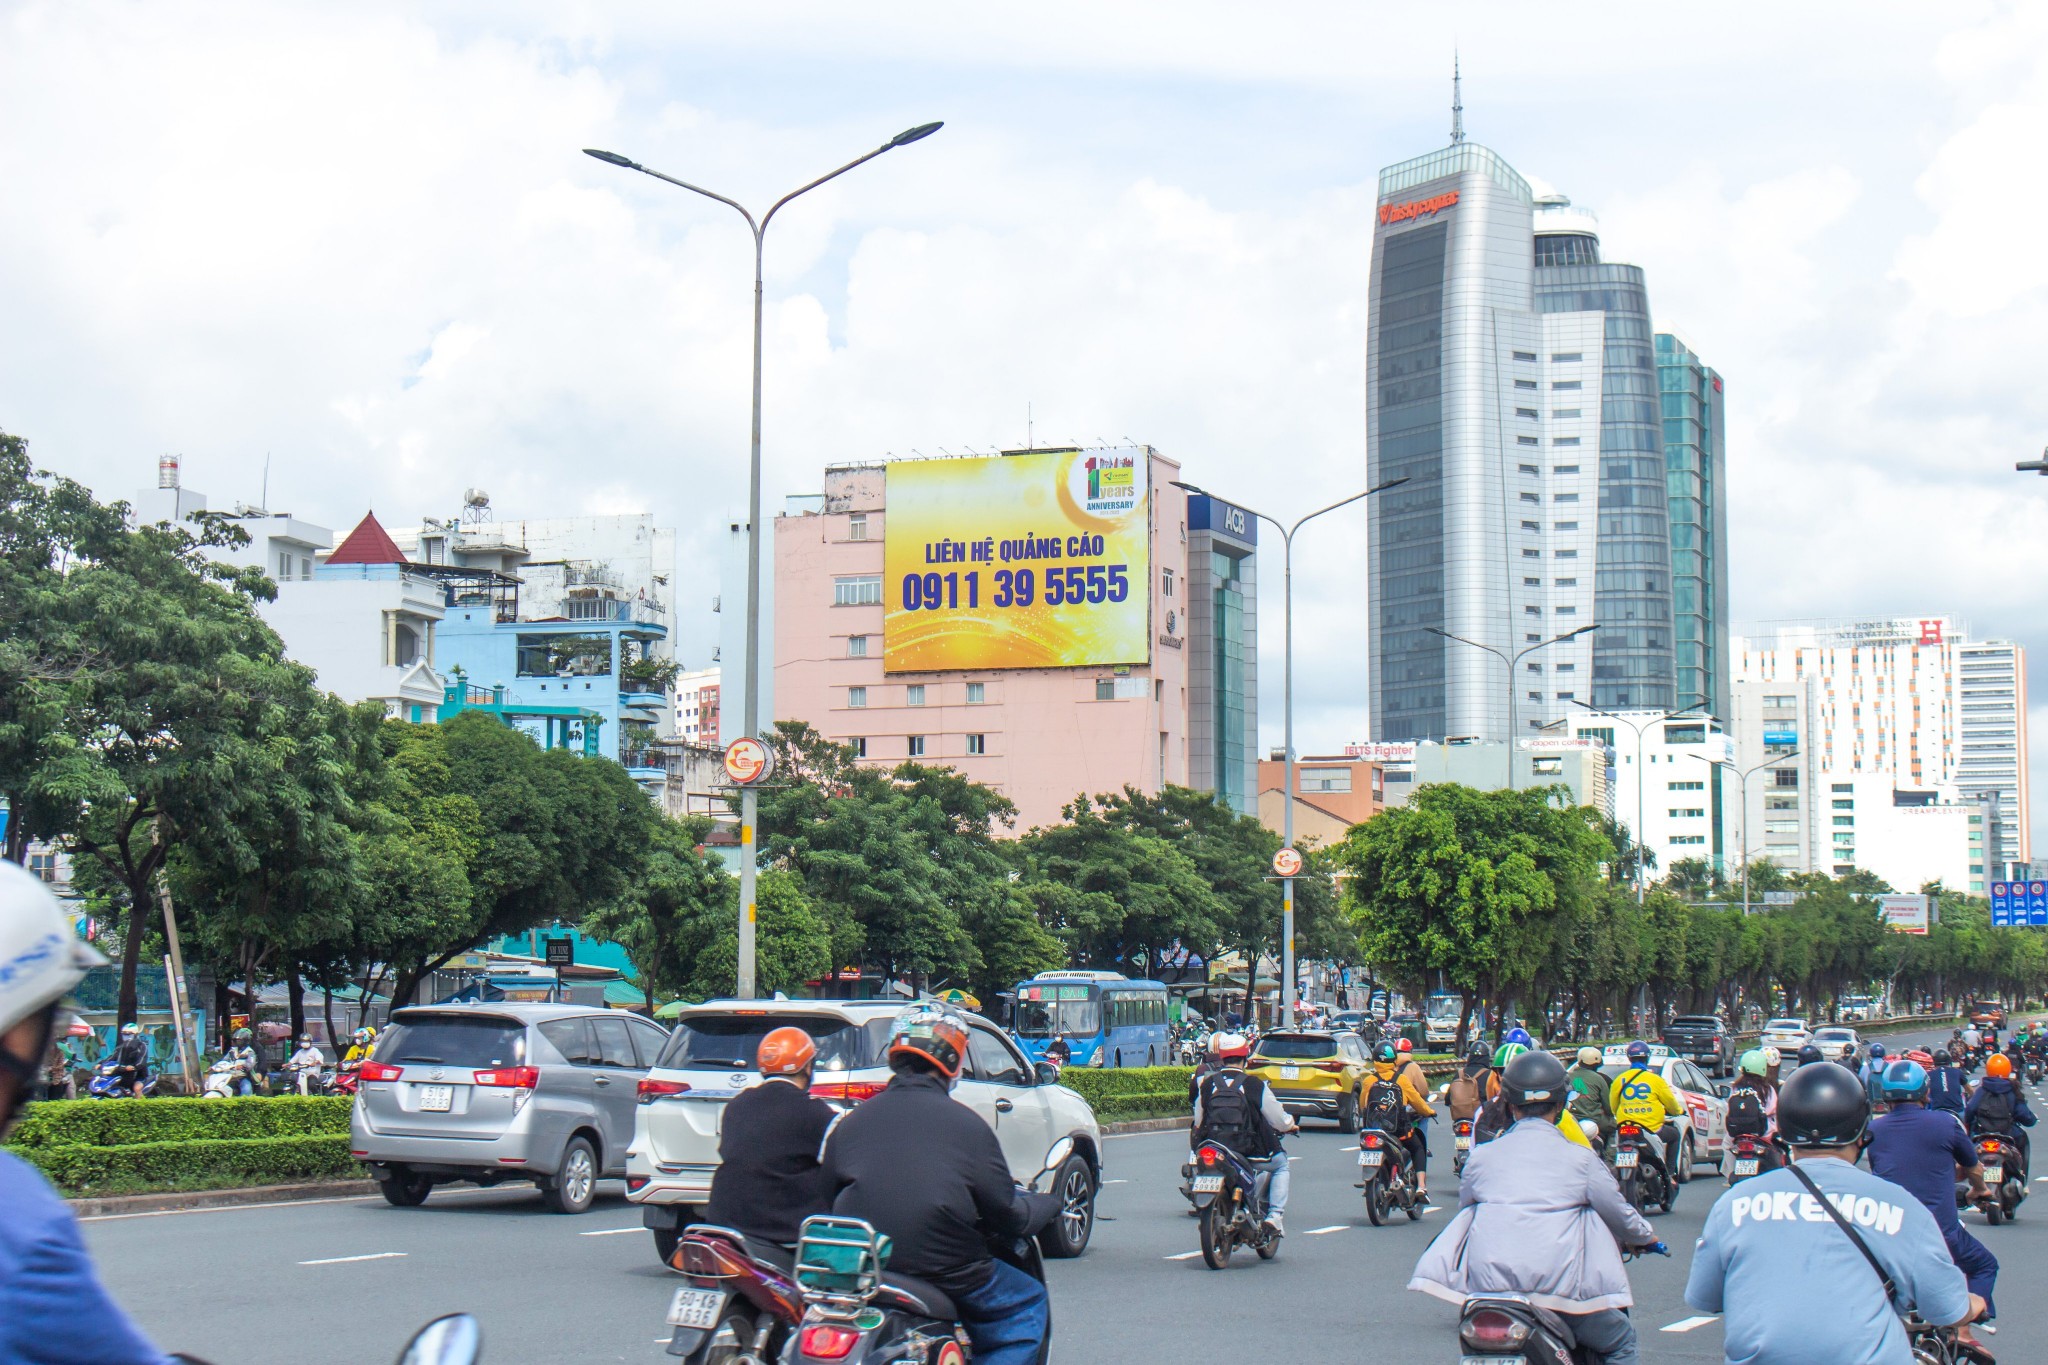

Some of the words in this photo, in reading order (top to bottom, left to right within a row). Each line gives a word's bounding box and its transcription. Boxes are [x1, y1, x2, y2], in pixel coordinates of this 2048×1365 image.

[1379, 189, 1460, 225] Whiskycognac
[1100, 485, 1135, 499] years
[1086, 501, 1134, 511] ANNIVERSARY
[1224, 506, 1246, 535] ACB
[926, 538, 966, 564] LIÊN
[970, 536, 994, 566] HỆ
[999, 531, 1062, 563] QUẢNG
[1066, 531, 1105, 557] CÁO
[902, 571, 979, 611] 0911
[993, 568, 1035, 608] 39
[1044, 564, 1129, 606] 5555
[1855, 621, 1883, 630] HONG
[1886, 620, 1913, 629] BANG
[1835, 630, 1913, 639] INTERNATIONAL
[1855, 638, 1912, 647] UNIVERSITY
[1345, 746, 1372, 756] IELTS
[1374, 745, 1413, 758] Fighter
[428, 1087, 445, 1098] 51G
[1621, 1077, 1652, 1101] be
[677, 1306, 711, 1325] 1636
